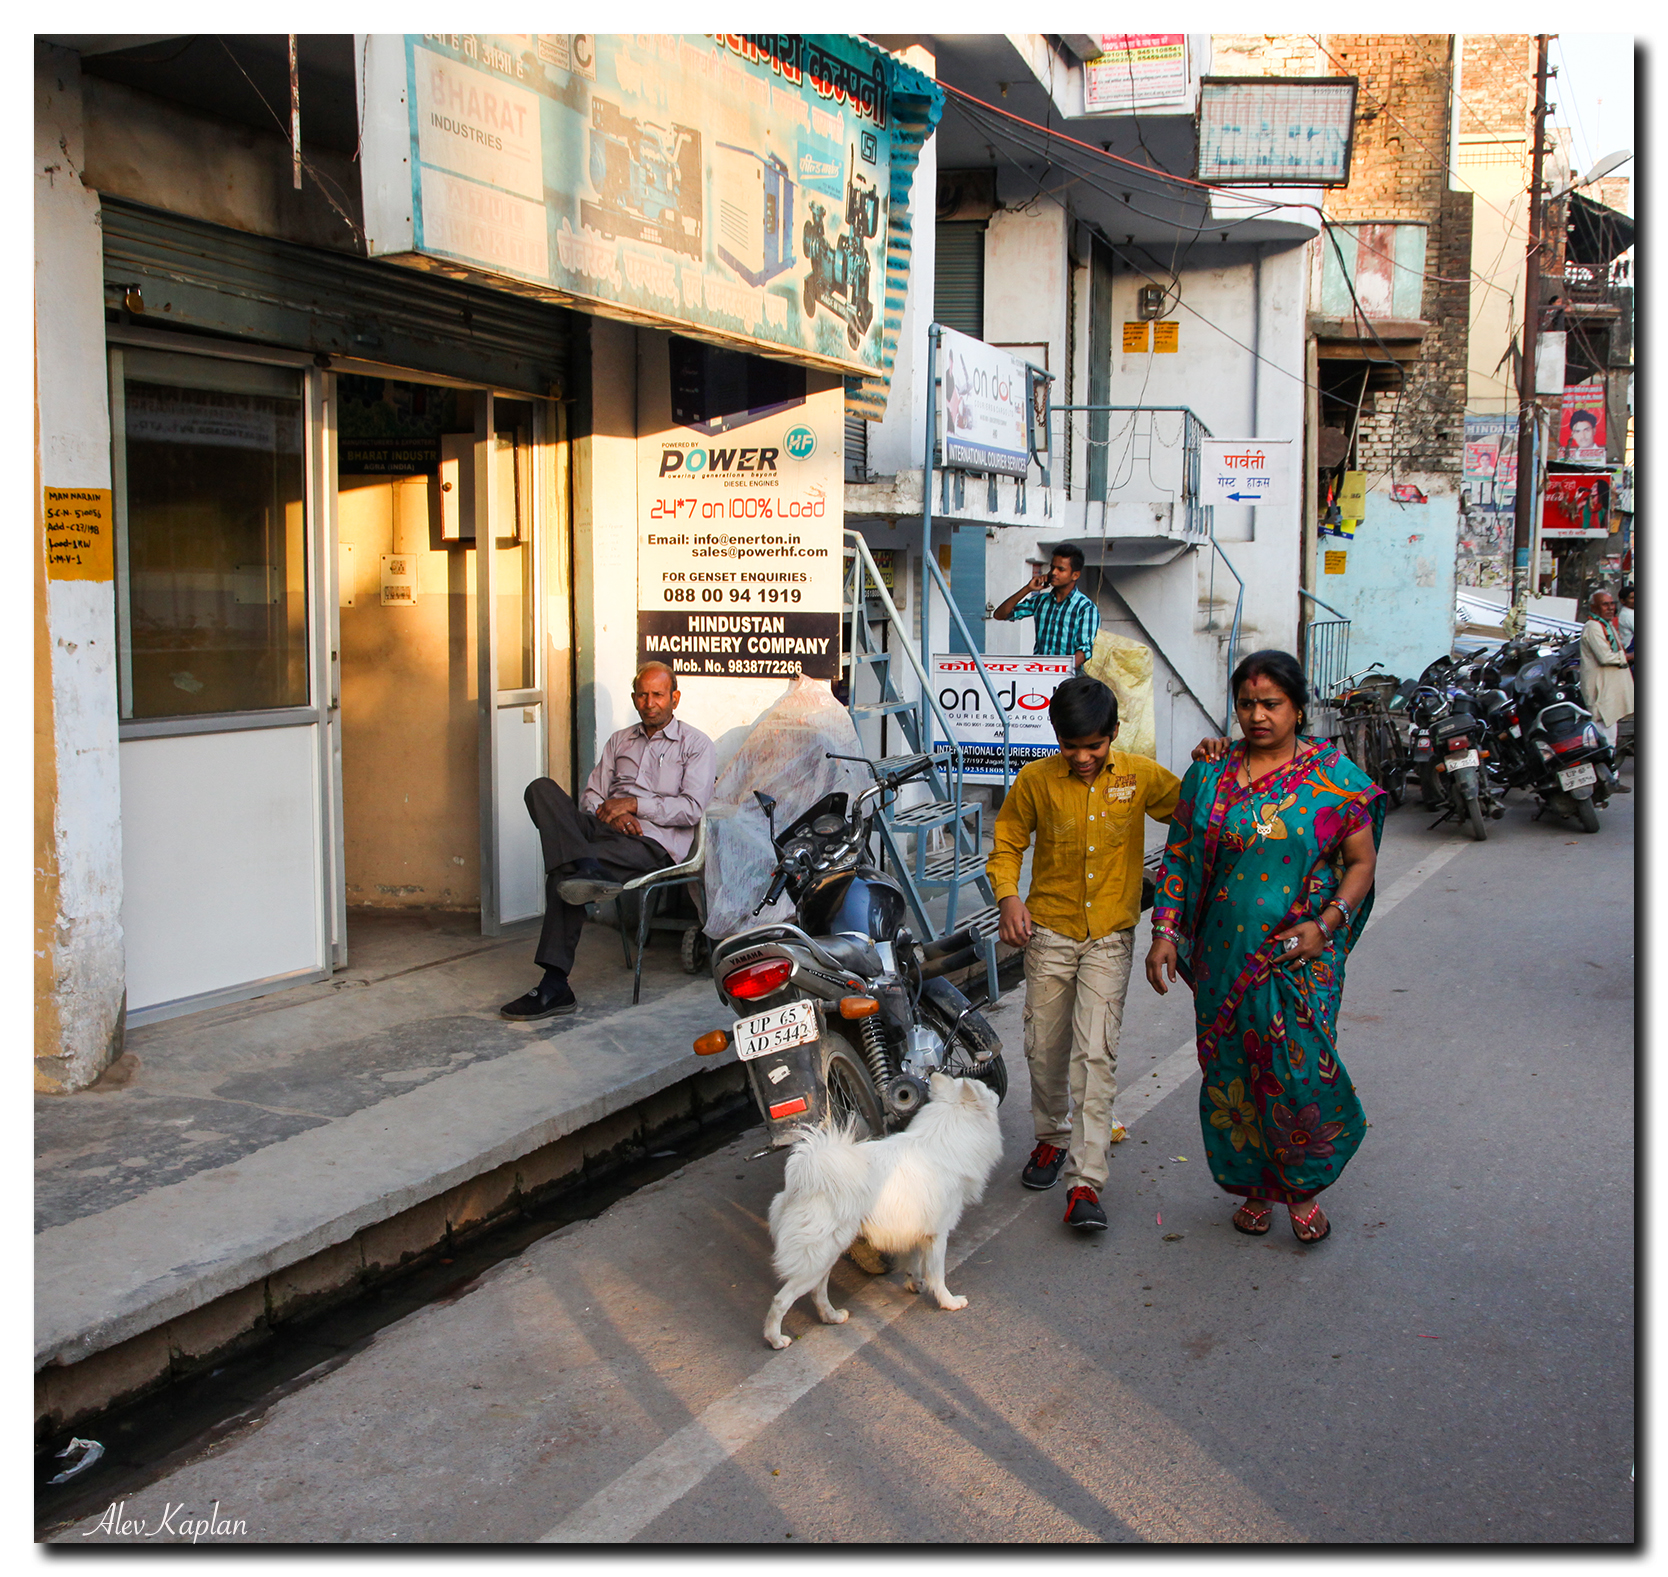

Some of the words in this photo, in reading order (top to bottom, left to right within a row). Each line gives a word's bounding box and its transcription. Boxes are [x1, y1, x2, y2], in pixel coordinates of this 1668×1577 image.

[807, 43, 890, 131] कम्पनी
[430, 69, 528, 139] BHARAT
[430, 112, 503, 151] INDUSTRIES
[447, 180, 524, 234] ATUL
[428, 213, 545, 271] SHAKTI
[973, 367, 988, 398] on
[991, 365, 1013, 406] dot
[348, 451, 388, 461] BHARAT
[659, 447, 779, 478] POWER
[949, 443, 988, 466] INTERNATIONAL
[988, 452, 1008, 470] COURIER
[1007, 456, 1027, 473] SERVICES
[1223, 449, 1266, 469] पार्वती
[387, 463, 415, 472] (INDIA)
[701, 472, 745, 480] generations
[751, 471, 777, 479] beyond
[1217, 473, 1237, 488] गेस्ट
[48, 492, 69, 501] MAN
[70, 492, 101, 501] NARAIN
[702, 502, 724, 519] on
[729, 498, 773, 519] 100%
[777, 497, 825, 518] Load
[648, 534, 690, 545] Email:
[694, 533, 801, 546] info@enerton.in
[692, 546, 828, 559] sales@powerhf.com
[662, 572, 686, 582] FOR
[689, 572, 737, 582] GENSET
[663, 588, 696, 602] 088
[701, 588, 723, 602] 00
[729, 588, 751, 602] 94
[758, 588, 802, 602] 1919
[688, 616, 785, 633] HINDUSTAN
[645, 636, 743, 653] MACHINERY
[747, 637, 830, 655] COMPANY
[673, 658, 701, 673] Mob.
[705, 659, 725, 673] No.
[728, 660, 802, 674] 9838772266
[1024, 661, 1069, 673] सेवा
[939, 688, 980, 711] on
[997, 681, 1058, 711] do
[730, 950, 764, 966] YAMAHA
[750, 1016, 771, 1035] UP
[779, 1008, 797, 1025] 65
[745, 1036, 769, 1055] AD
[774, 1023, 808, 1046] 5442
